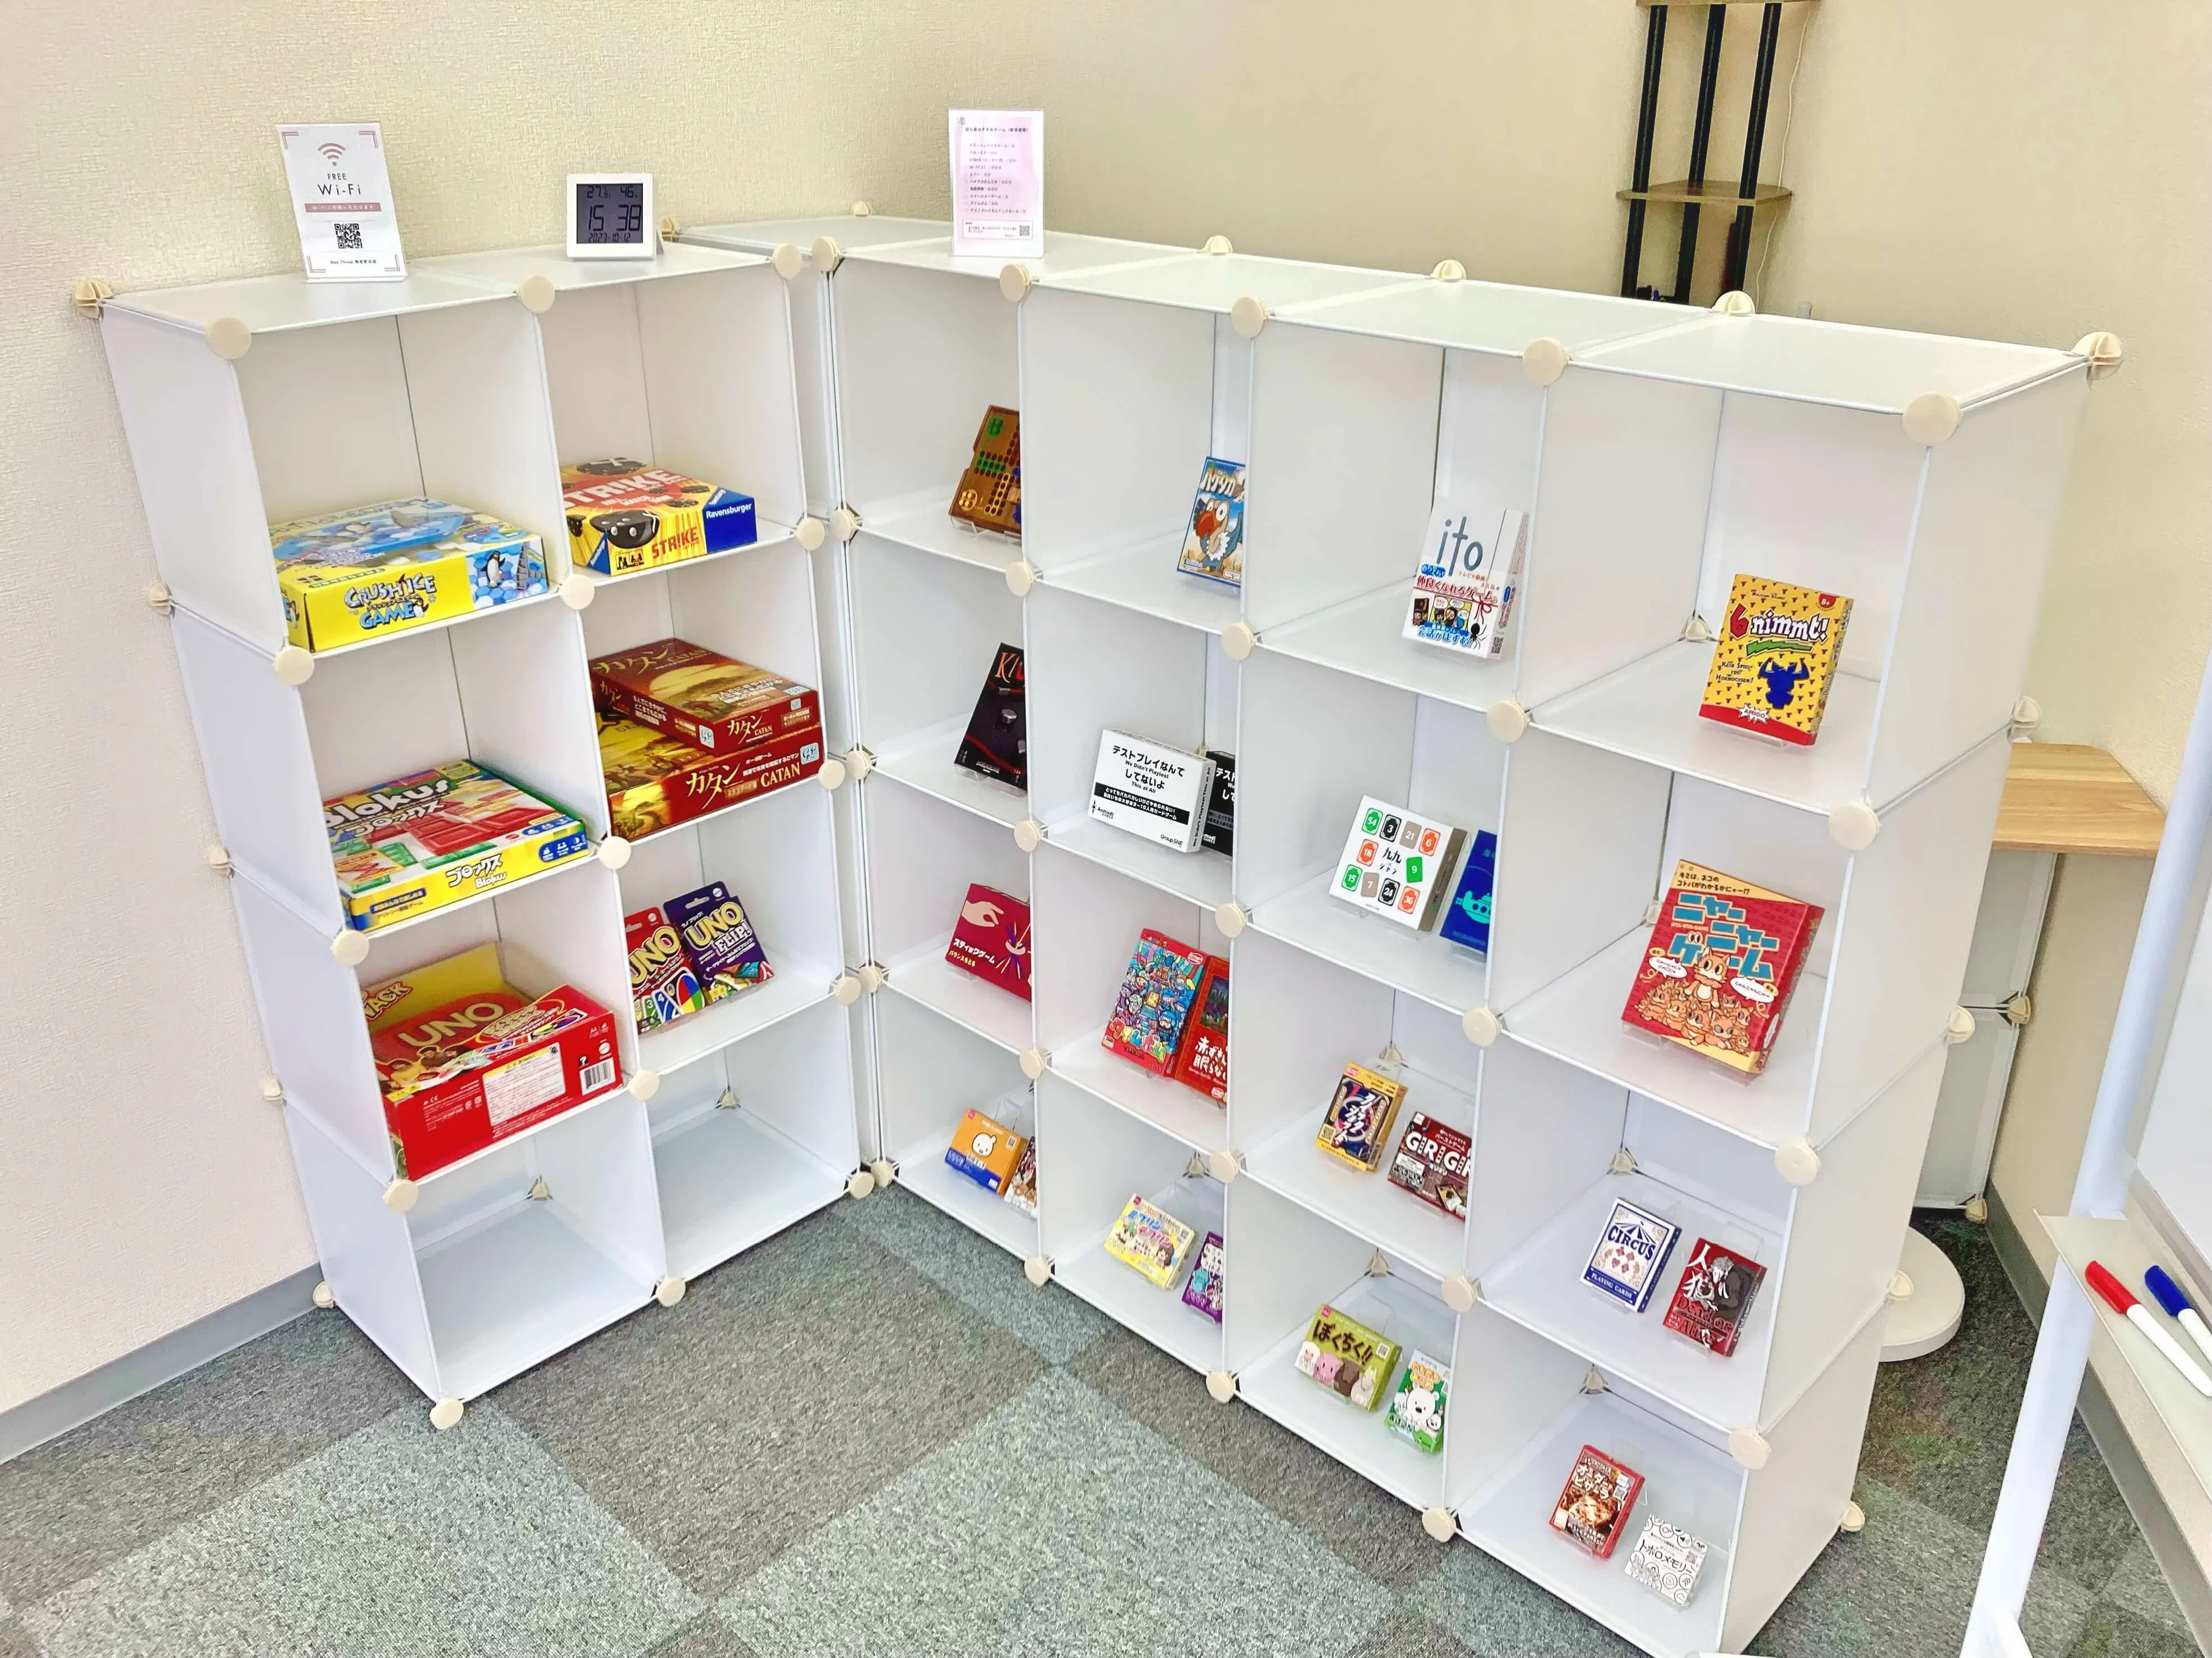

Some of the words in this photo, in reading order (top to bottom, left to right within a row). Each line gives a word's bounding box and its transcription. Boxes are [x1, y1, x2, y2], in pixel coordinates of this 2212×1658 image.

[318, 184, 361, 196] Wi-Fi
[706, 503, 752, 519] Ravensburger
[1436, 516, 1483, 576] ito
[406, 573, 437, 594] ICE
[1821, 598, 1830, 606] 8+
[360, 601, 416, 629] GAME
[1730, 603, 1749, 639] 6
[1751, 610, 1830, 643] nimmt!
[1744, 709, 1766, 719] AMIGO
[727, 713, 763, 745] カタン
[755, 725, 773, 736] CATAN
[1113, 745, 1185, 777] テストプレイなんて
[1134, 762, 1148, 771] Didn't
[1149, 767, 1169, 779] Playtest
[760, 762, 800, 788] CATAN
[1125, 769, 1165, 789] してないよ
[686, 762, 741, 810] カタン
[1368, 816, 1377, 827] 54
[1405, 830, 1415, 840] 21
[1426, 838, 1431, 847] 6
[1382, 847, 1402, 864] 九九
[475, 871, 507, 888] Blokus
[1348, 874, 1356, 882] 15
[1384, 887, 1394, 897] 24
[685, 902, 743, 950] UNO
[713, 921, 752, 954] FLIP!
[628, 926, 681, 987] UNO
[953, 938, 995, 964] スティックゲーム
[647, 999, 654, 1009] 3
[397, 1003, 504, 1047] UNO
[1607, 1225, 1656, 1261] CIRCUS
[1591, 1273, 1614, 1289] PLAYING
[1614, 1284, 1633, 1298] CARDS
